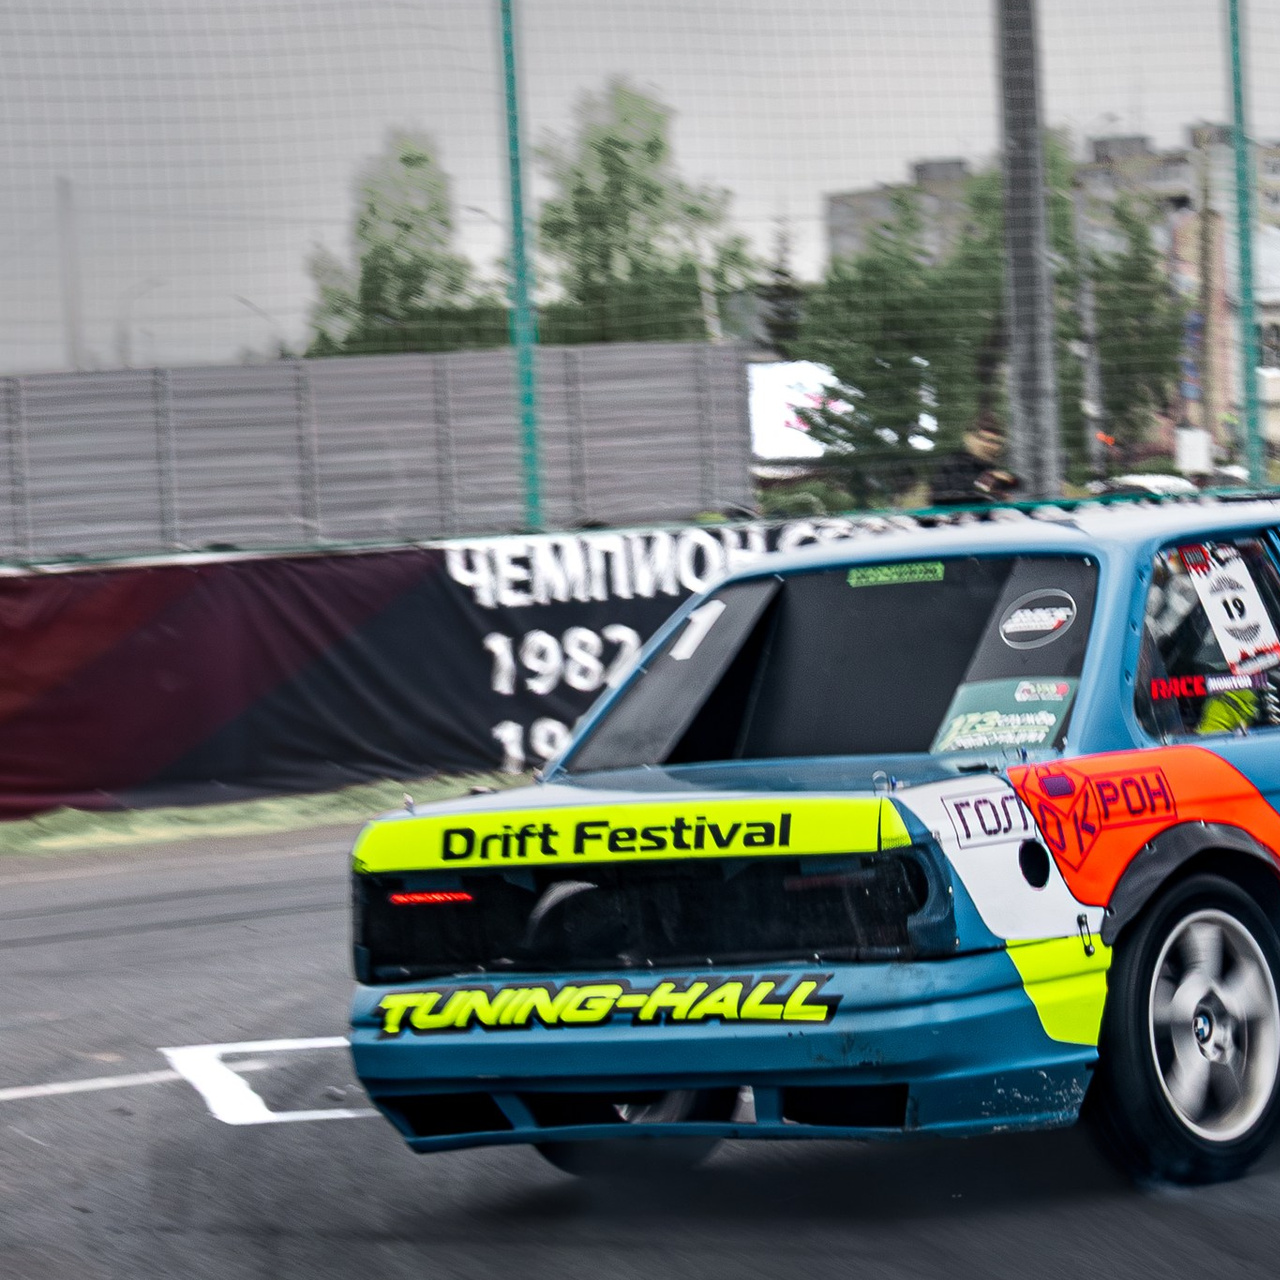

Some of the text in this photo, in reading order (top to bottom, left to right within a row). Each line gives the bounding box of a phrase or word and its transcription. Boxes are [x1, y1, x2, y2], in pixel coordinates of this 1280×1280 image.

[1220, 597, 1247, 621] 19
[482, 623, 643, 695] 1982
[441, 813, 792, 861] Drift Festival
[377, 978, 832, 1035] TUNING-HALL
